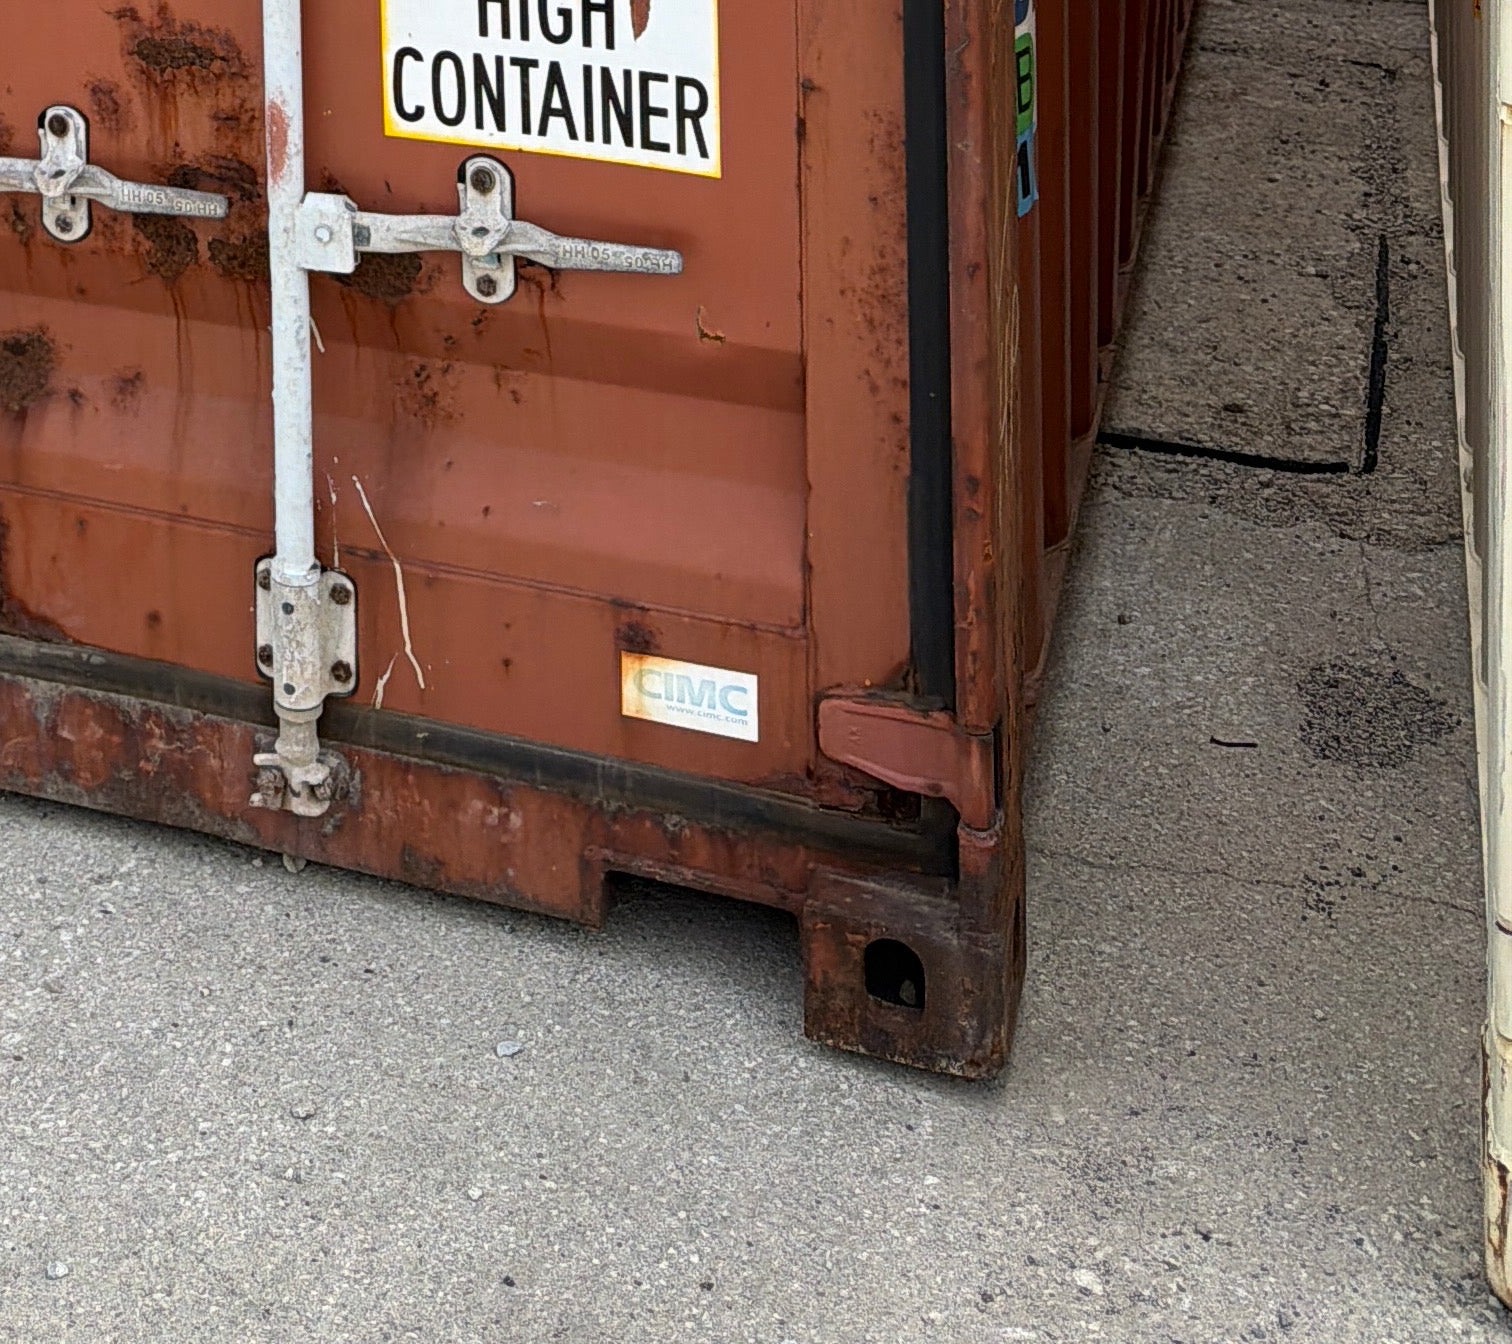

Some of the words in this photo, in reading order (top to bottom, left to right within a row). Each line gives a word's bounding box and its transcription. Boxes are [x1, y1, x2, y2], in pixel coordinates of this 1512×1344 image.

[393, 46, 709, 159] CONTAINER
[1015, 46, 1033, 115] B
[633, 668, 748, 717] CIMC
[666, 704, 748, 726] www.cimc.com
